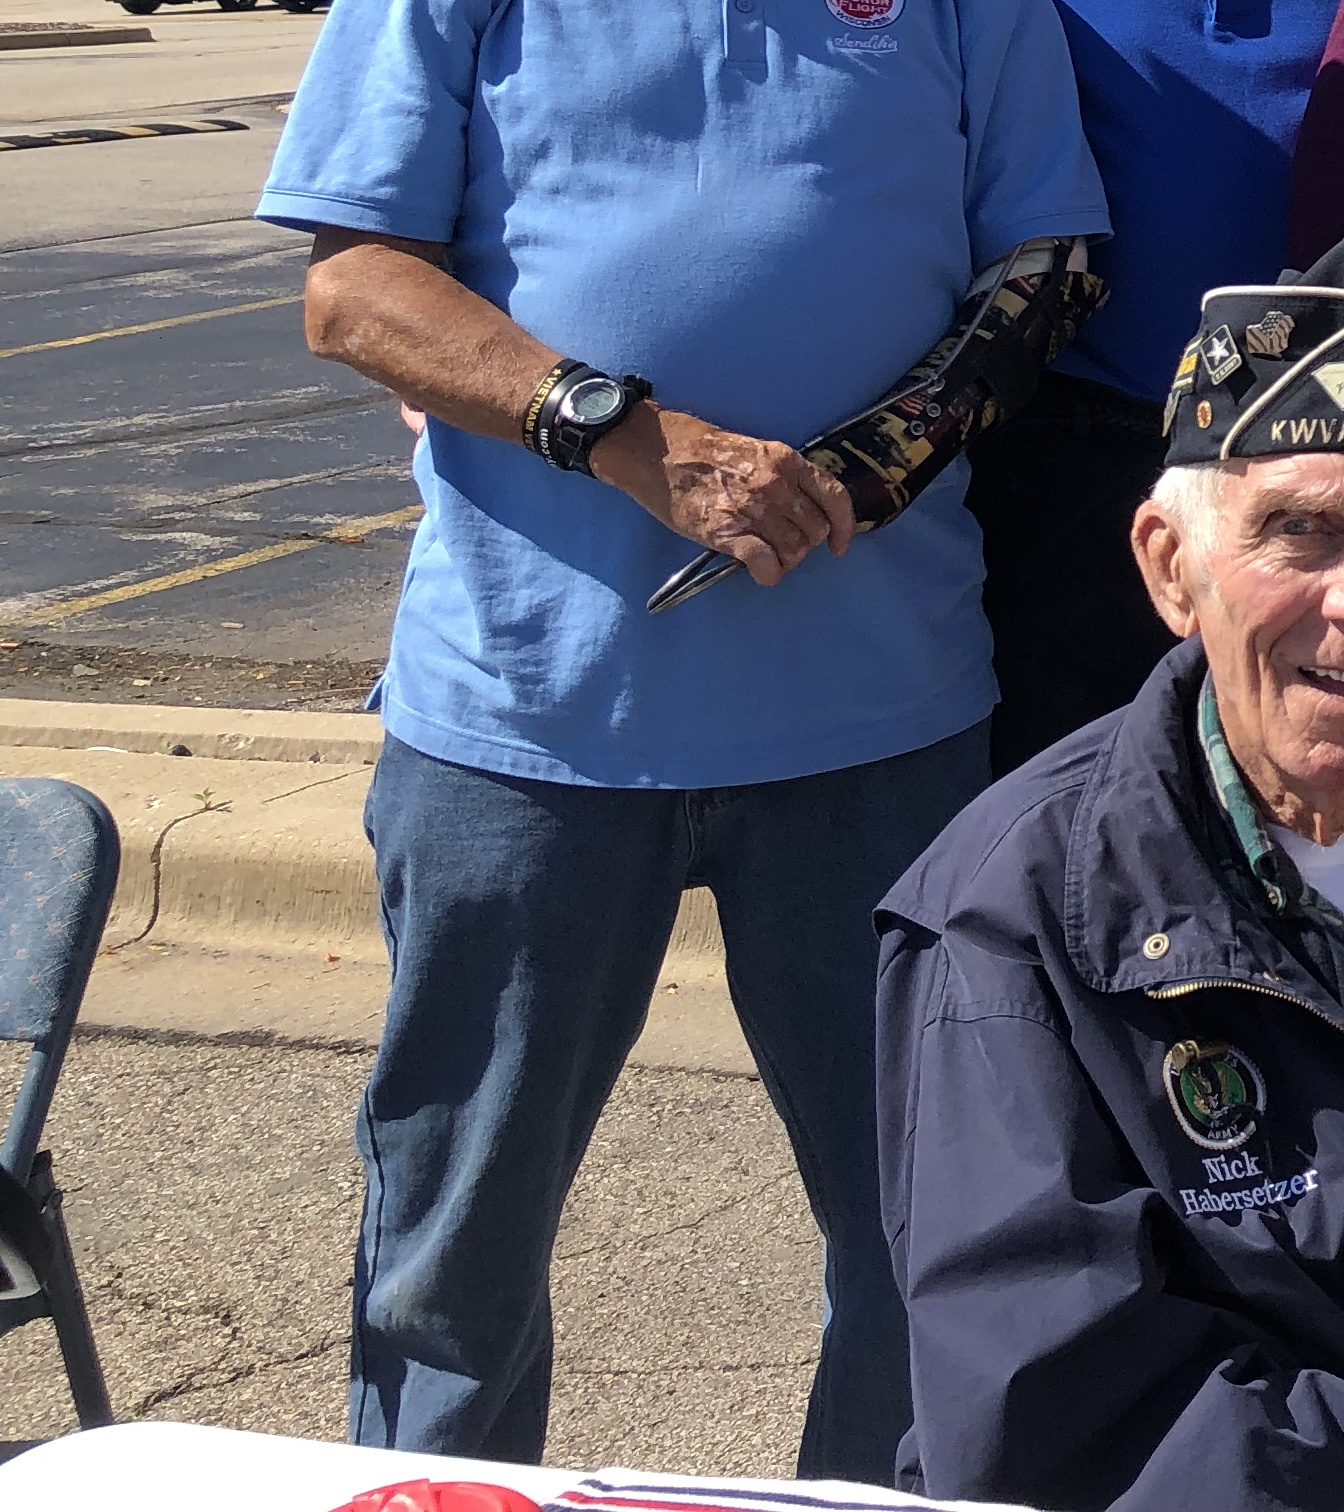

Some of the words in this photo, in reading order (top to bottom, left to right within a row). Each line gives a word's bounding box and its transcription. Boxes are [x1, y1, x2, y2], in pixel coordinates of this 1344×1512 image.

[840, 0, 889, 14] FLIGHT
[525, 376, 558, 432] VIETNAM
[1201, 1150, 1264, 1184] Nick
[1179, 1168, 1319, 1215] Habersetzer
